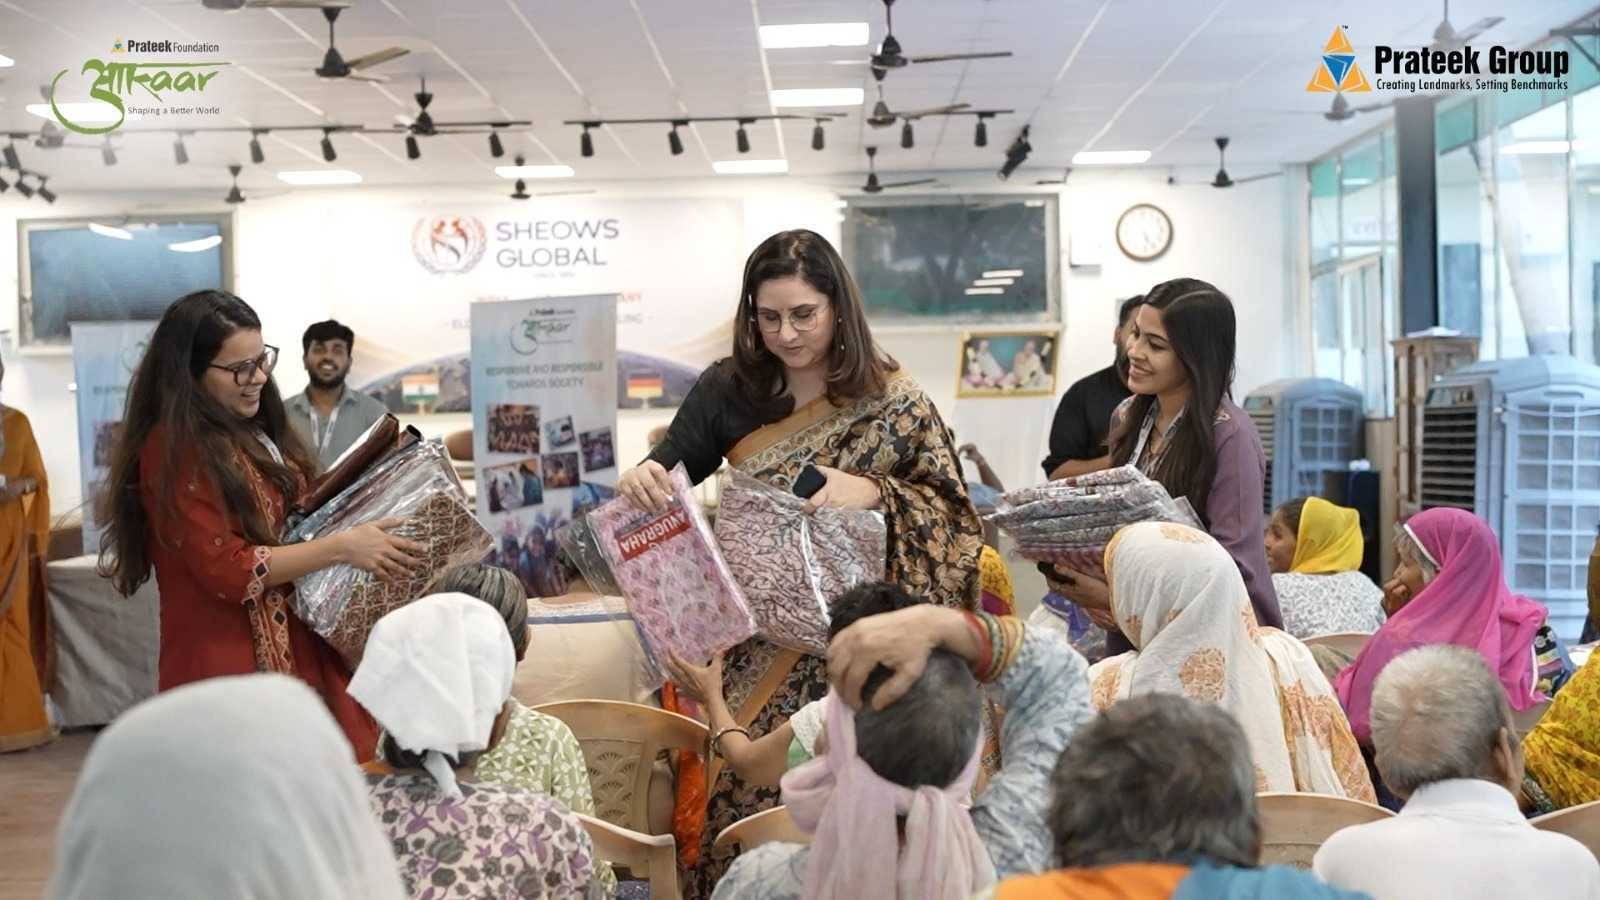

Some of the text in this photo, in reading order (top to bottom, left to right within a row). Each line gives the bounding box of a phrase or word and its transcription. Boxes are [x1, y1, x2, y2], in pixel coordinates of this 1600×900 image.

[496, 219, 620, 241] SHEOWS
[496, 247, 608, 268] GLOBAL
[532, 364, 550, 374] AND
